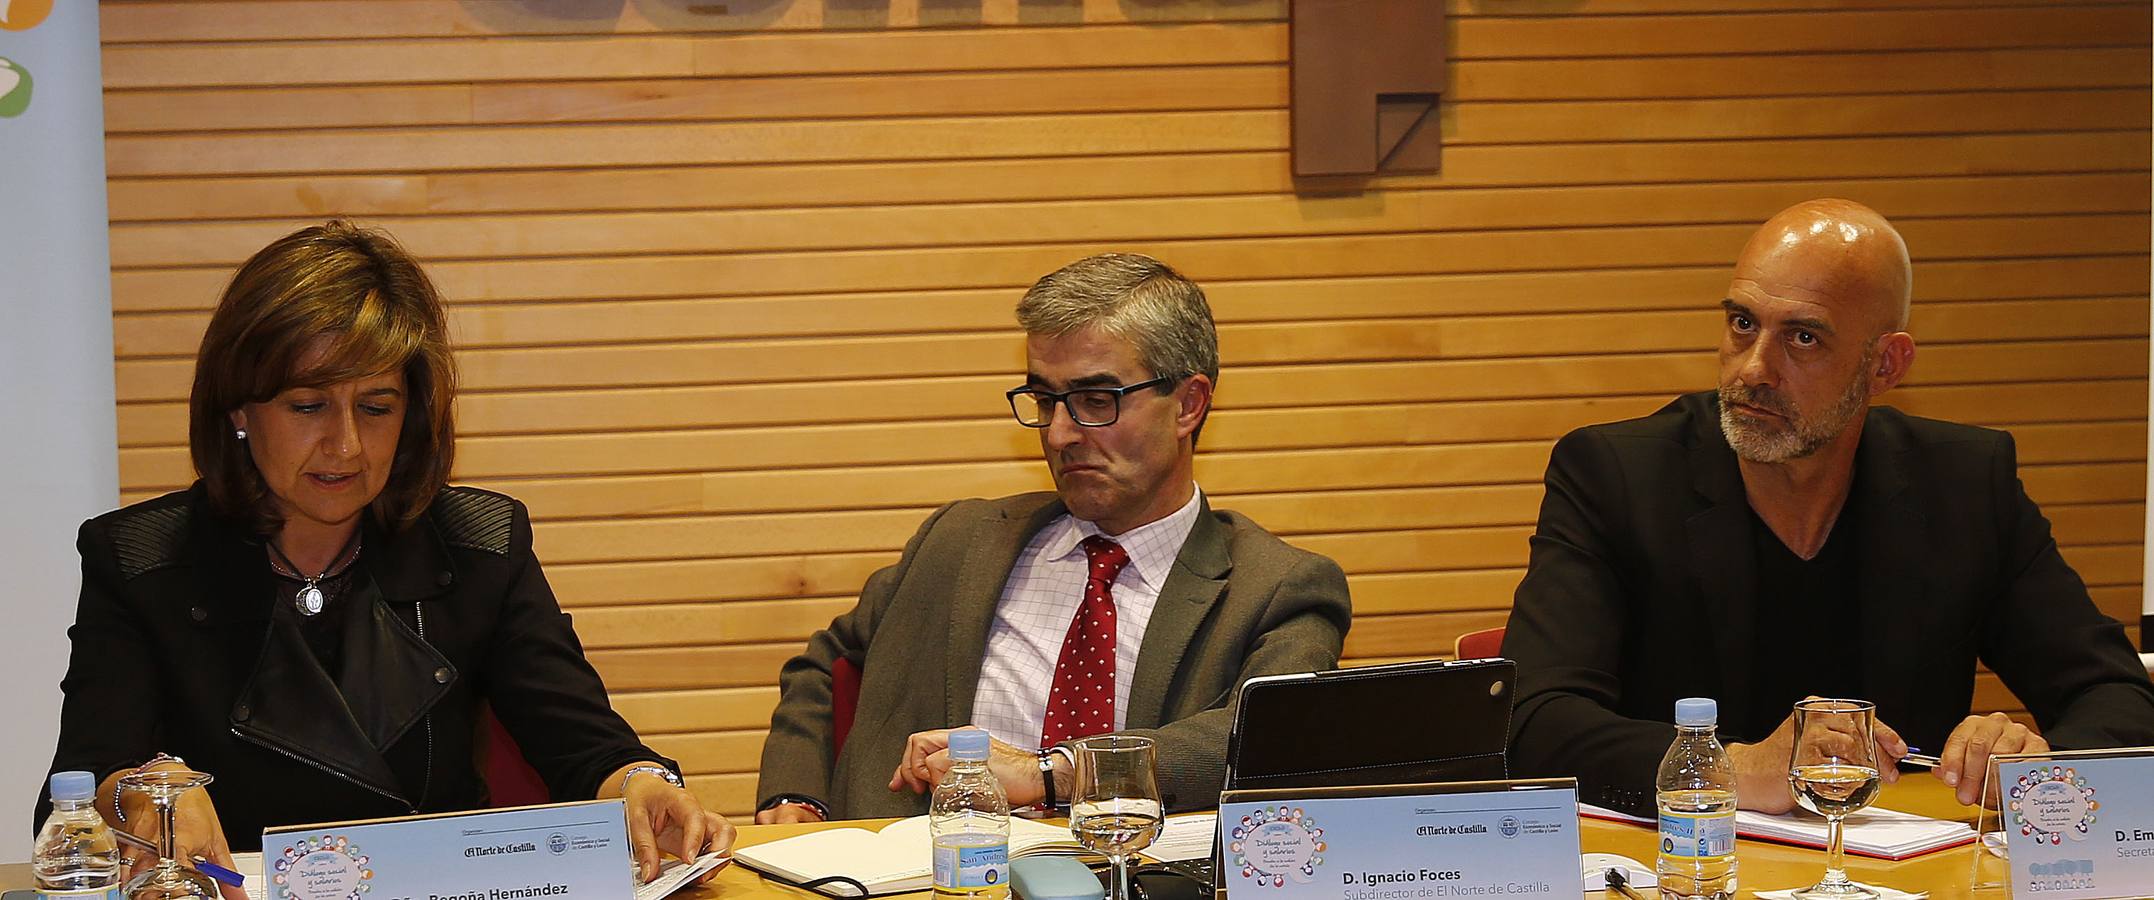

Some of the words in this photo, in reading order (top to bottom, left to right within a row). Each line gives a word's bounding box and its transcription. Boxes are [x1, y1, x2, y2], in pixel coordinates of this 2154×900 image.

[1427, 826, 1448, 836] Norte
[1457, 824, 1487, 835] Castilla
[2115, 830, 2130, 842] D.
[2134, 829, 2154, 841] Em
[475, 846, 496, 857] Norte
[506, 842, 536, 854] Castilla
[1343, 872, 1359, 885] D.
[1363, 869, 1416, 887] Ignacio
[1420, 869, 1461, 882] Foces
[489, 882, 568, 900] Hernández
[1344, 887, 1415, 900] Subdirector
[1418, 887, 1433, 898] de
[1437, 885, 1448, 898] El
[1451, 884, 1485, 897] Norte
[1488, 883, 1503, 895] de
[1506, 881, 1550, 894] Castilla
